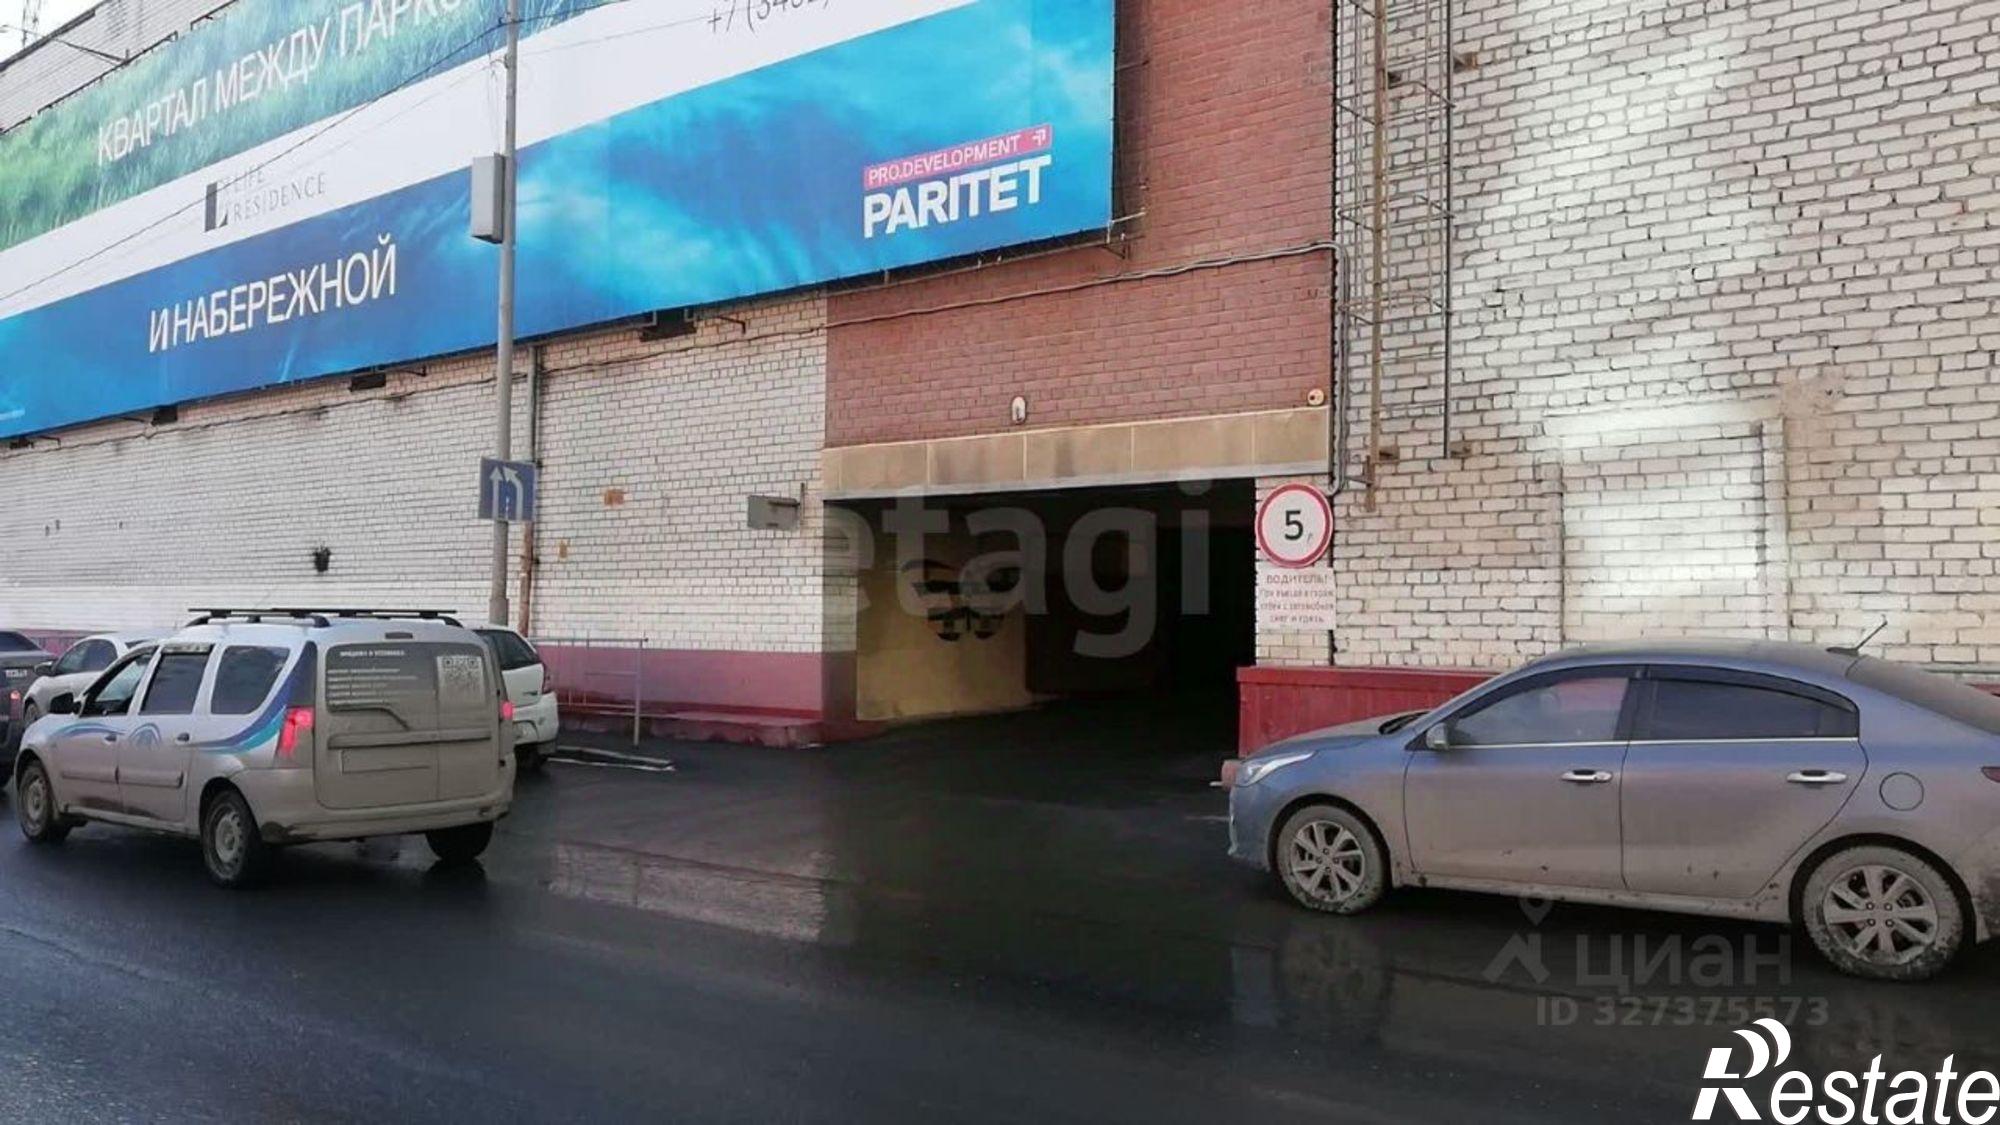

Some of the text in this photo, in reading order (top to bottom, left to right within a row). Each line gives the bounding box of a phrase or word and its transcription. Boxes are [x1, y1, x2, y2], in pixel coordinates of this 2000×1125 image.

[98, 77, 208, 167] КВАРТАЛ
[215, 17, 330, 114] МЕЖДУ
[869, 134, 1022, 187] PRO.DEVELOPMENT
[233, 172, 328, 222] RESIDENCE
[863, 154, 1052, 239] PARITET
[149, 232, 397, 353] И НАБЕРЕЖНОЙ
[1285, 509, 1304, 541] 5
